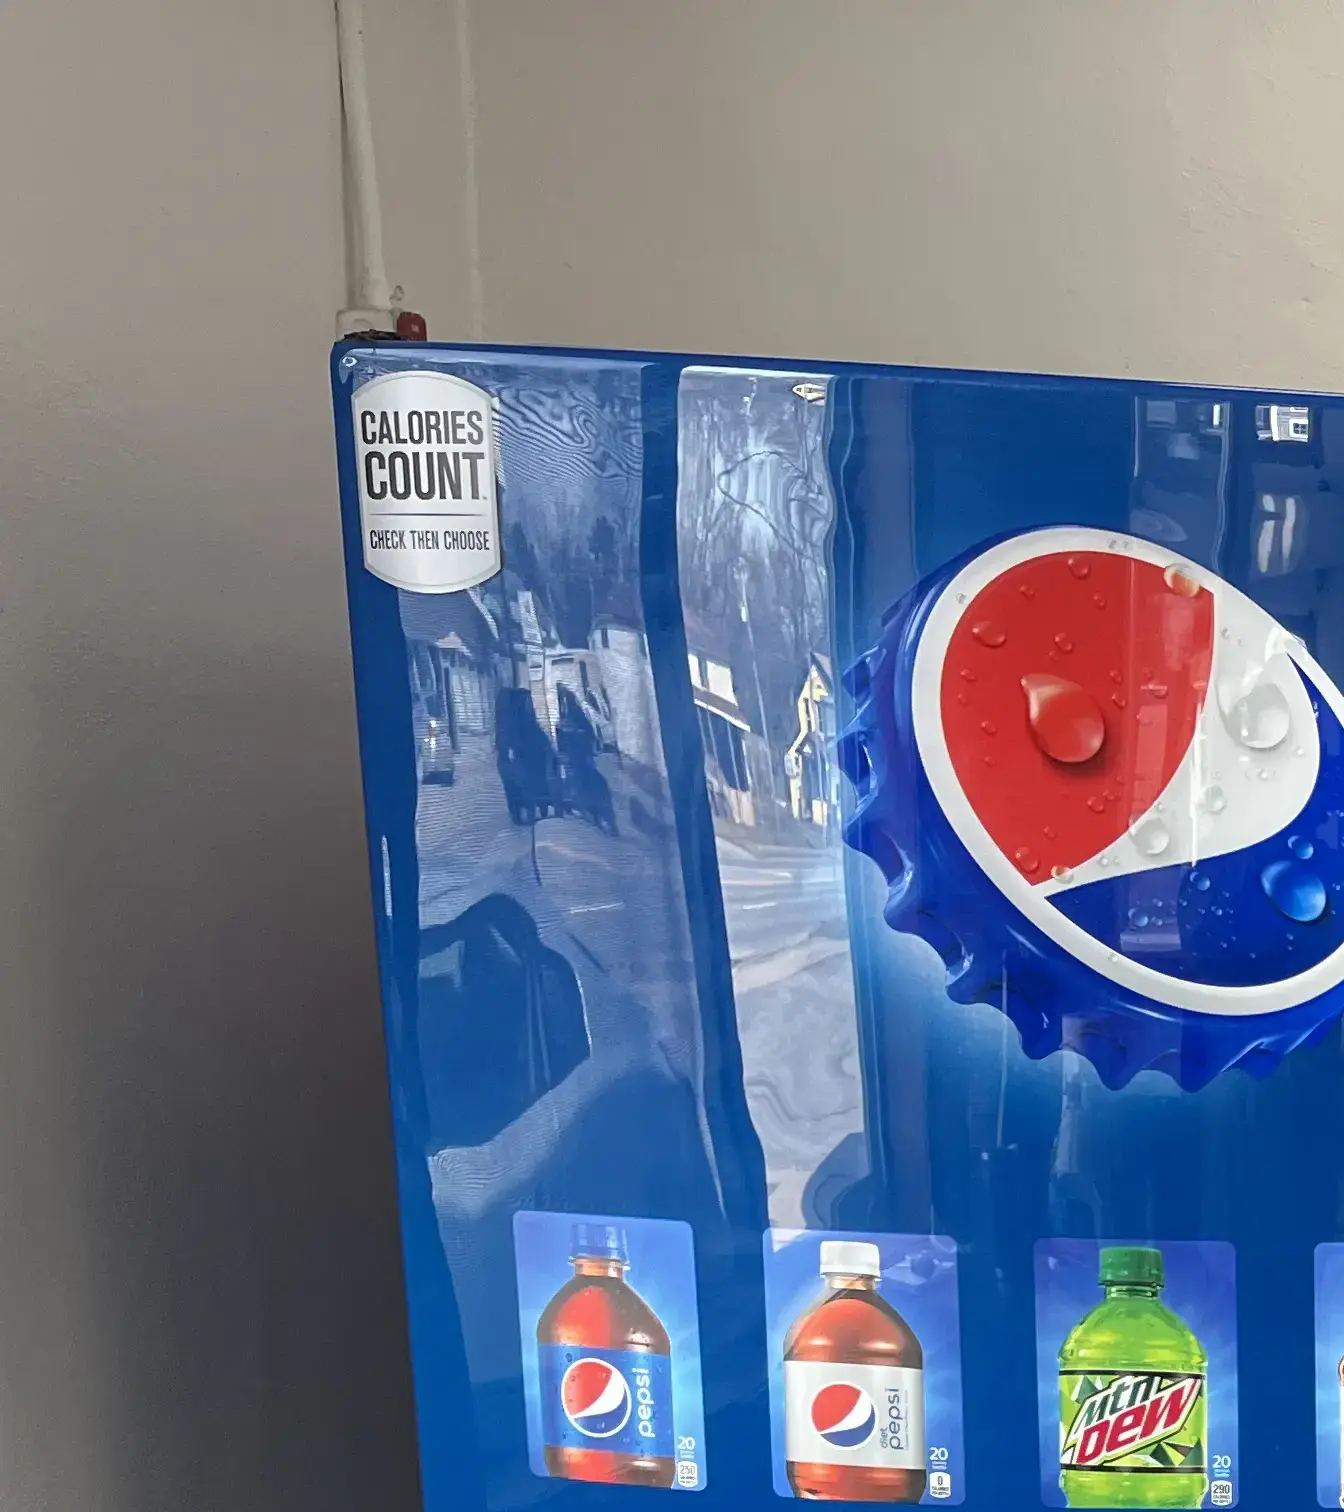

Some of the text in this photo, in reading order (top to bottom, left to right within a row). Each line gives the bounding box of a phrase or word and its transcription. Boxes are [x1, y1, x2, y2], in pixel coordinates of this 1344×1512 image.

[360, 410, 484, 445] CALORIES
[364, 450, 485, 501] COUNT
[370, 530, 490, 551] CHECK THEN CHOOSE
[633, 1367, 656, 1438] pepsi
[1074, 1375, 1156, 1434] Mtn
[885, 1388, 904, 1450] pepsi
[677, 1435, 696, 1451] 20
[880, 1427, 888, 1448] diet
[929, 1446, 949, 1461] 20
[1212, 1455, 1232, 1468] 20
[937, 1475, 943, 1486] 0
[1213, 1484, 1231, 1494] 290
